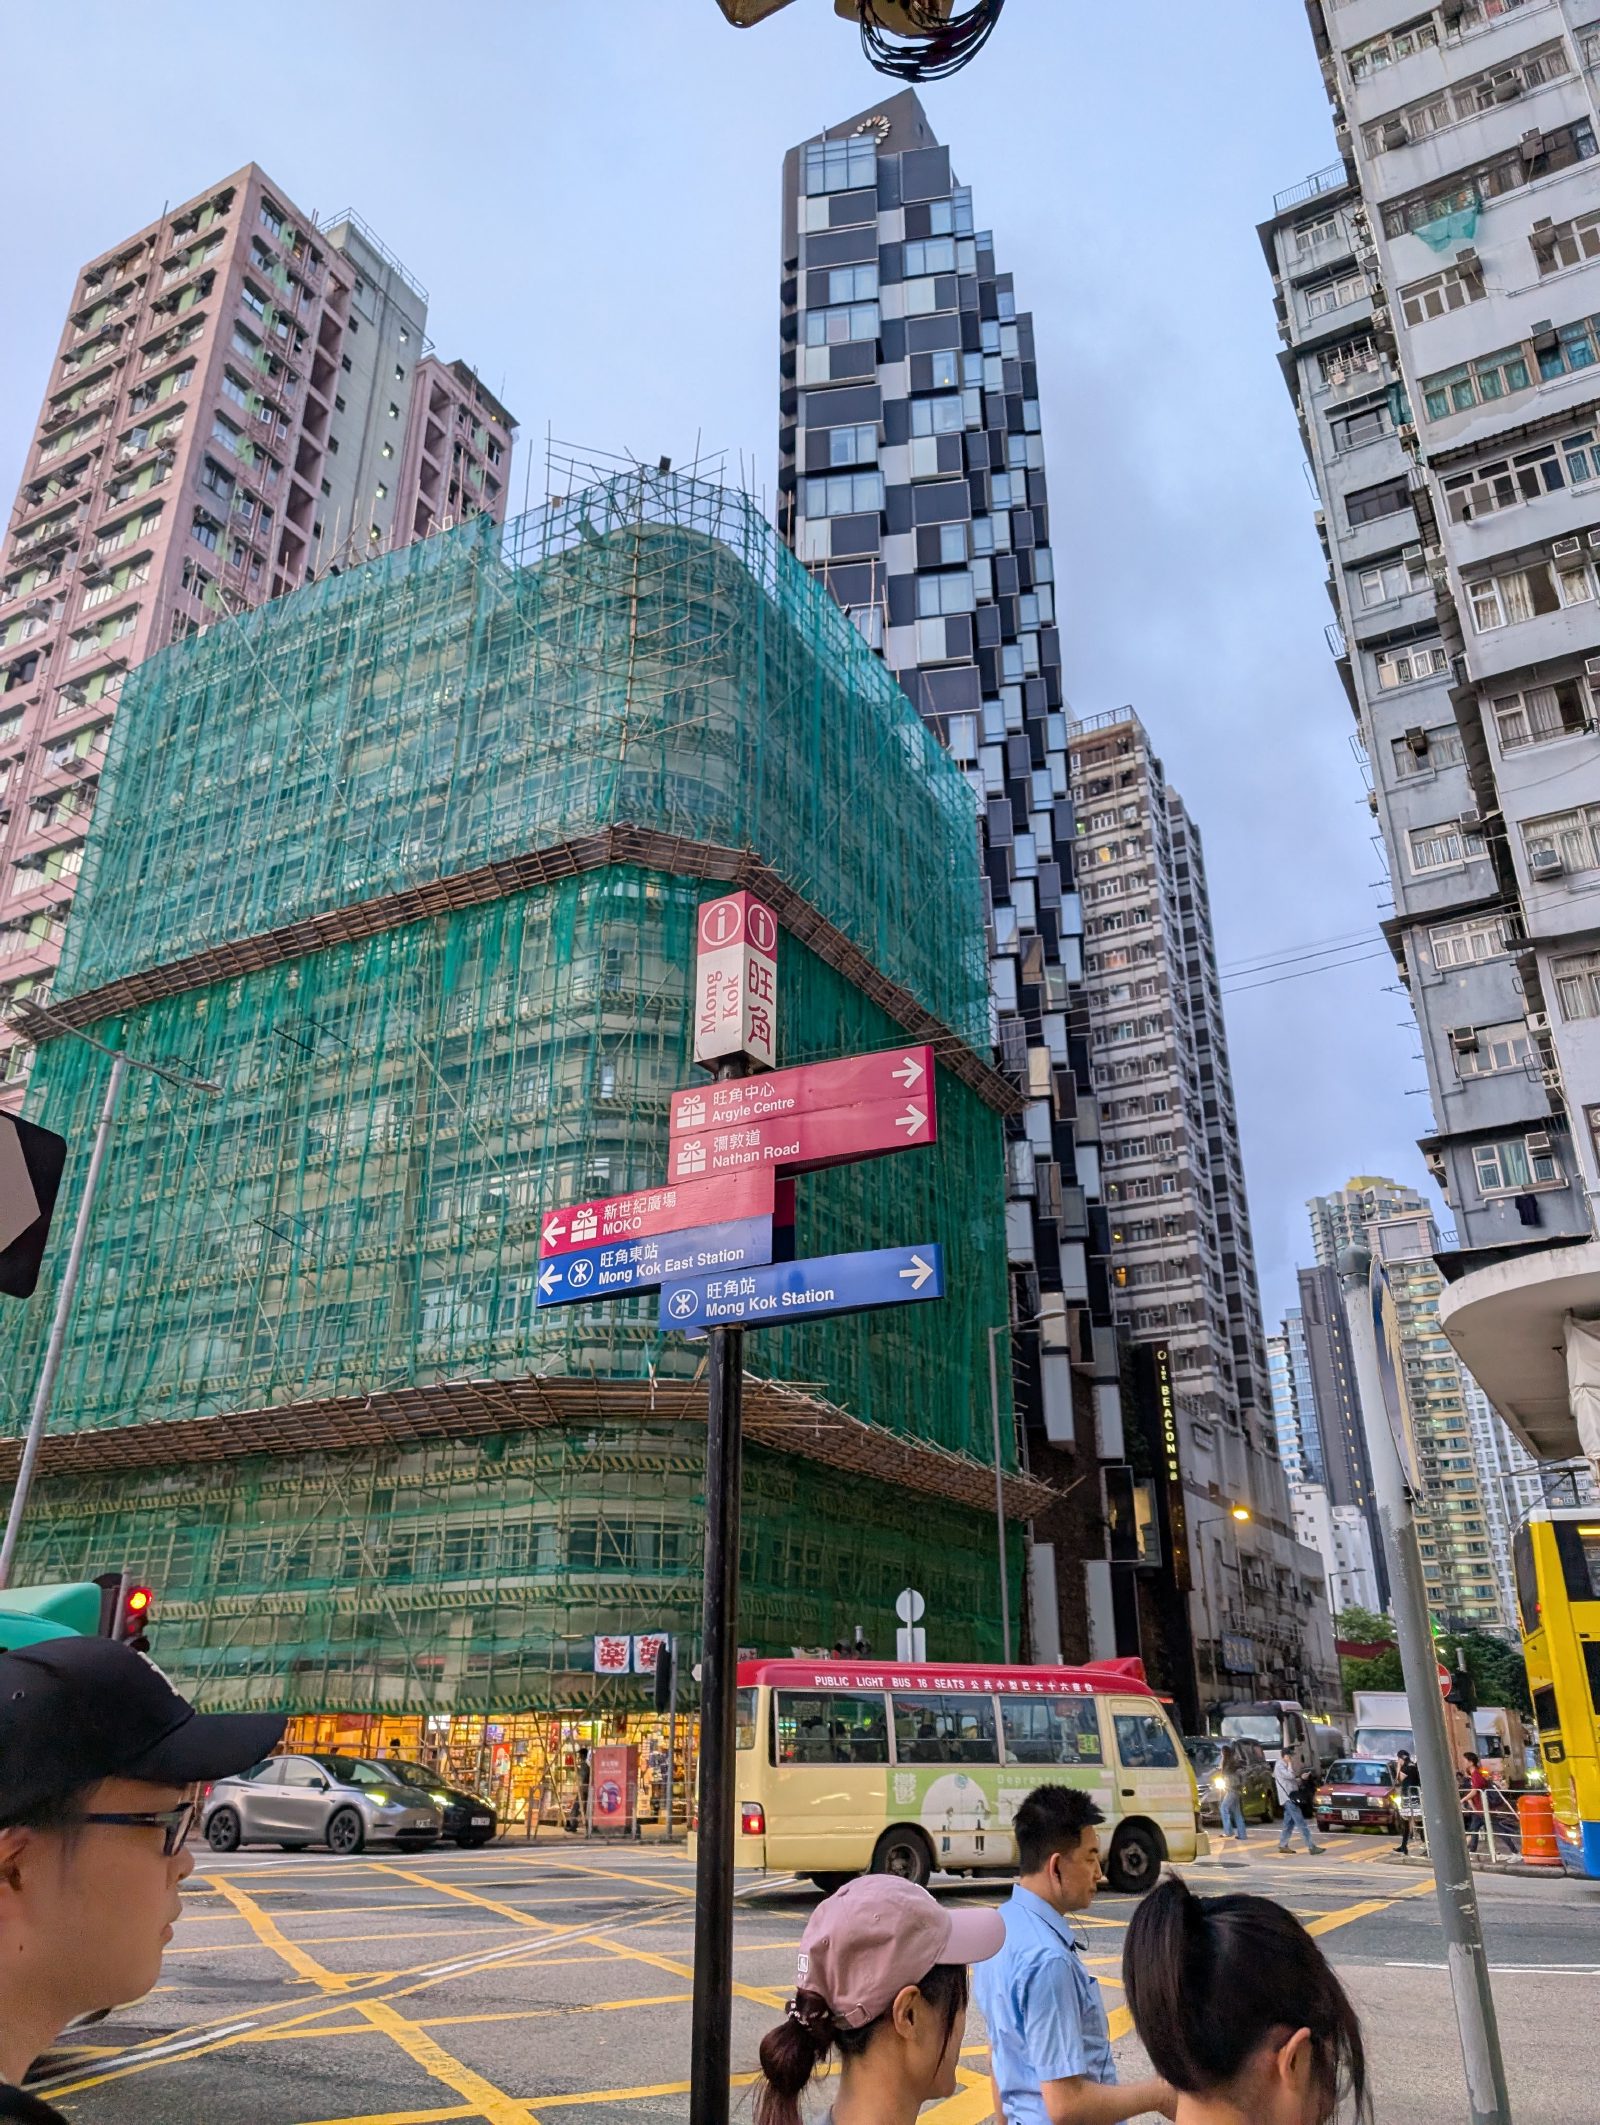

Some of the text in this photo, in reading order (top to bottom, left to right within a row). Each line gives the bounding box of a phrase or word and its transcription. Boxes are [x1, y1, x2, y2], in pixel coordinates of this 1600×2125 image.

[701, 970, 723, 1036] Mong
[723, 974, 739, 1021] Kok
[748, 958, 774, 1055] 旺角
[713, 1082, 775, 1106] 旺角中心
[712, 1098, 795, 1122] Argyle Centre
[713, 1128, 761, 1153] 彌敦道
[713, 1141, 800, 1168] Nathan Road
[603, 1191, 676, 1221] 新世紀廣場
[602, 1217, 642, 1236] MOKO
[599, 1248, 744, 1285] Mong Kok East Station
[600, 1242, 659, 1268] 旺角東站
[707, 1276, 756, 1299] 旺角站
[706, 1288, 834, 1317] Mong Kok Station
[1161, 1385, 1176, 1454] BEACON
[814, 1676, 965, 1689] PUBLIC LIGHT BUS 16 SEATS
